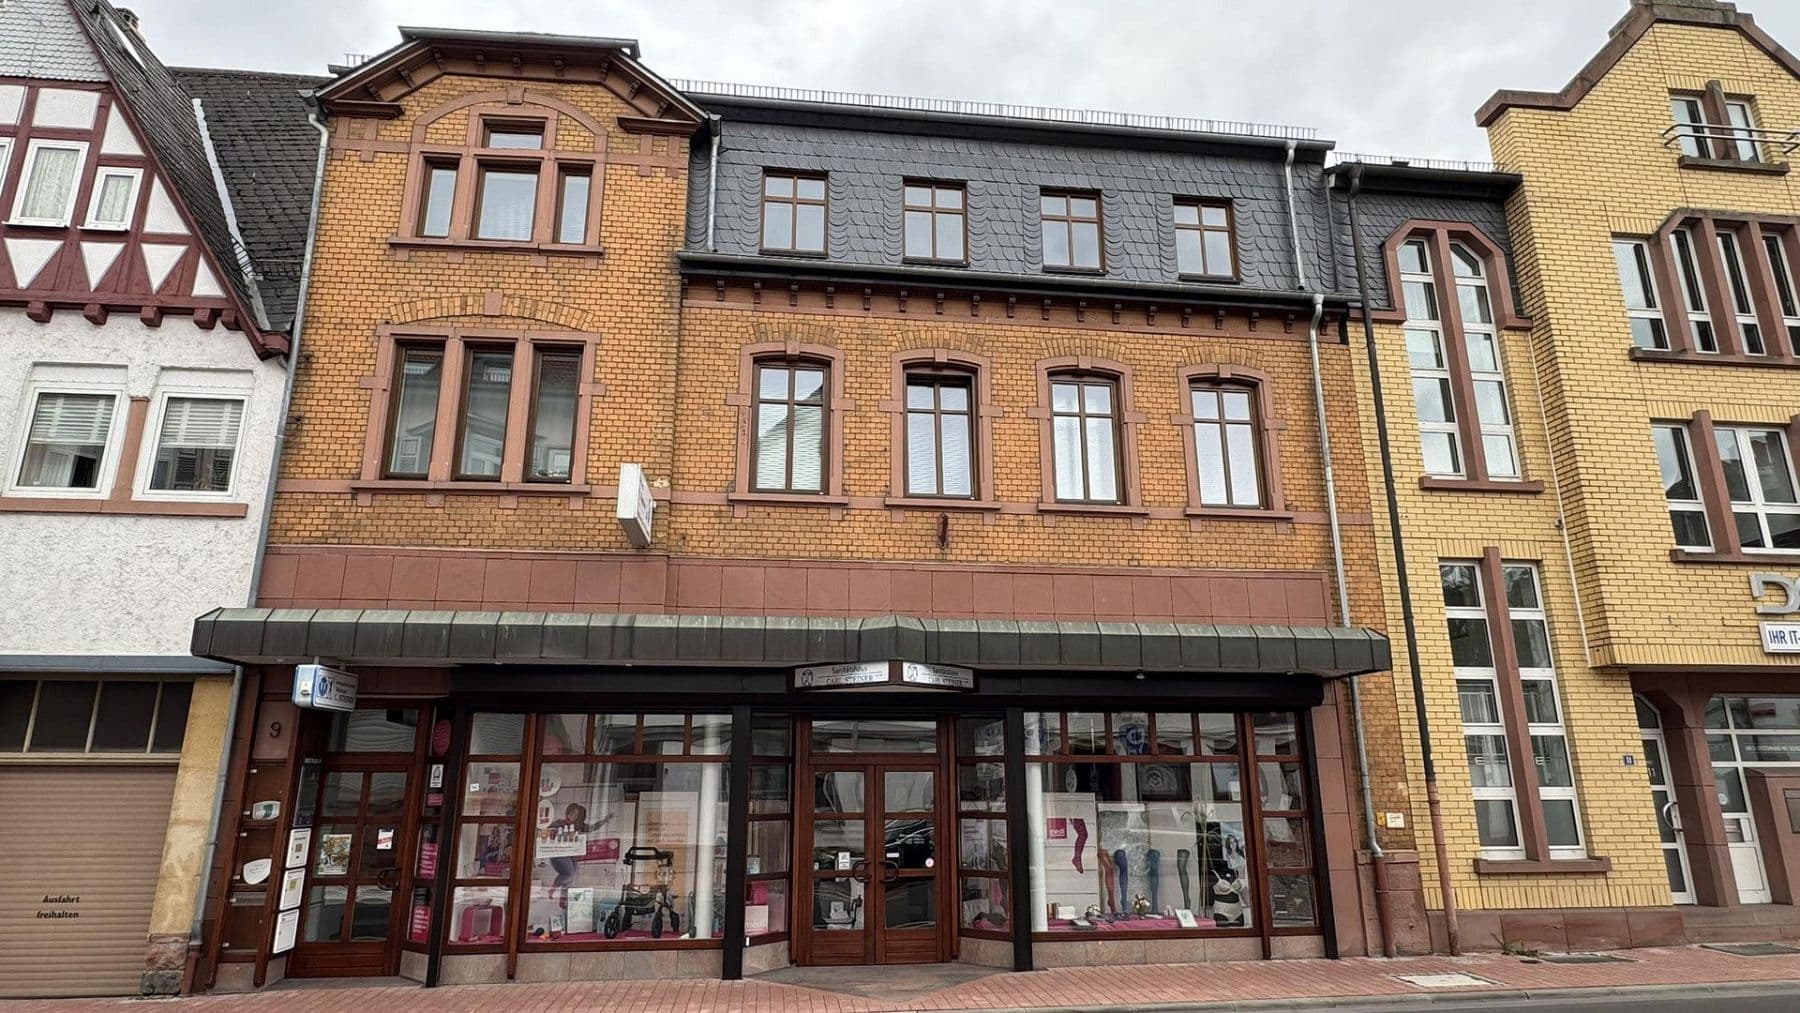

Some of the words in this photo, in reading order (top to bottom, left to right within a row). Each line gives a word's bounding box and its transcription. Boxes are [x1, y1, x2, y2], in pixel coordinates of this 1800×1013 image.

[1768, 630, 1787, 644] IHR
[270, 721, 281, 738] 9
[42, 895, 80, 903] Ausfahrt
[36, 910, 80, 919] freihalten
